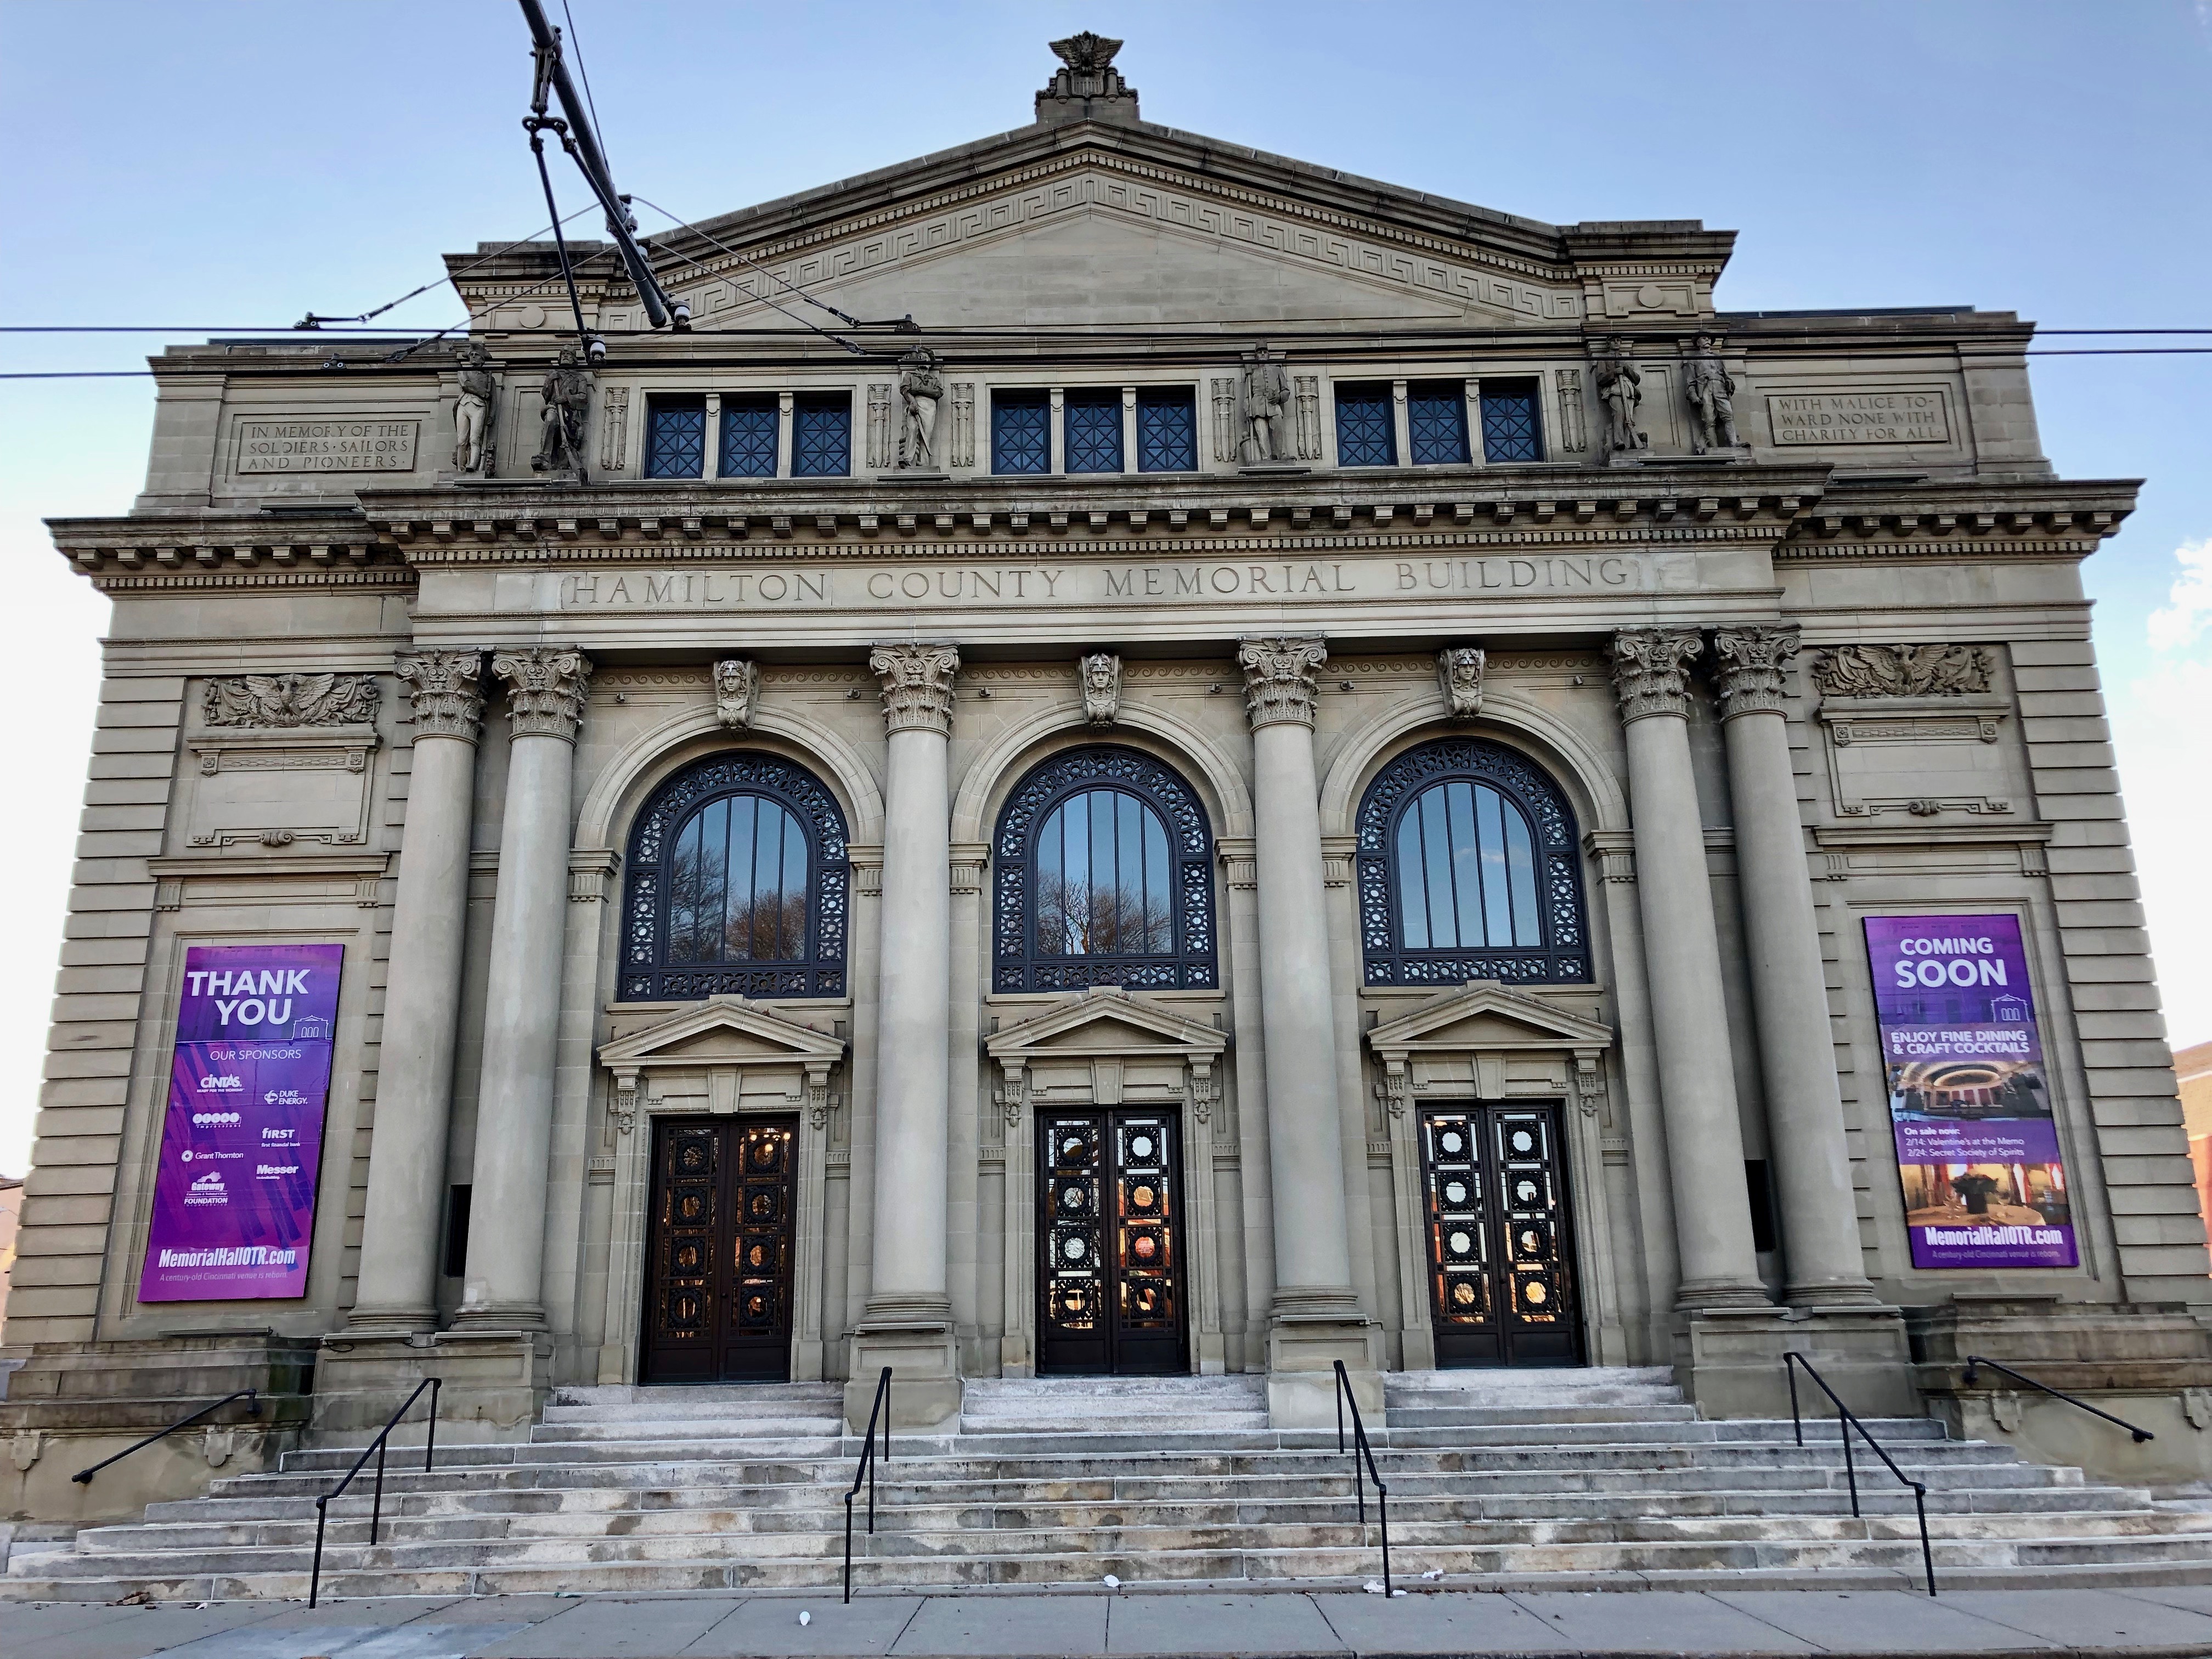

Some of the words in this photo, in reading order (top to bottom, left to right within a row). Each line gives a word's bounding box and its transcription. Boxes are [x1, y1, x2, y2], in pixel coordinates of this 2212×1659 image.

[1779, 399, 1821, 410] WITH
[1831, 397, 1895, 410] MALICE
[1782, 414, 1832, 426] WARD
[1839, 413, 1884, 425] NONE
[1893, 411, 1936, 424] WITH
[252, 426, 269, 438] IN
[351, 425, 372, 437] OF
[377, 425, 408, 437] THE
[1783, 428, 1858, 441] CHARITY
[1867, 428, 1897, 439] FOR
[339, 440, 408, 453] SAILORS
[248, 457, 290, 470] AND
[570, 574, 825, 603] HAMILTON
[867, 570, 1065, 599] COUNTY
[1103, 564, 1356, 597] MEMORIAL
[1395, 559, 1627, 590] BUILDING
[1900, 937, 1994, 955] COMING
[1895, 959, 2008, 988] SOON
[187, 969, 311, 996] THANK
[215, 998, 292, 1025] YOU
[1891, 1031, 1937, 1042] ENJOY
[1940, 1031, 1972, 1042] FINE
[1975, 1030, 2028, 1042] DINING
[210, 1051, 235, 1060] OUR
[239, 1049, 302, 1060] SPONSORS
[1893, 1044, 1904, 1054] &
[1906, 1043, 1950, 1054] CRAFT
[1954, 1042, 2030, 1053] COCKTAILS
[194, 1113, 239, 1122] DECAL
[1919, 1126, 1937, 1135] sale
[1905, 1138, 1927, 1146] 2/14:
[1982, 1137, 1996, 1145] the
[1997, 1137, 2024, 1146] Memo
[1957, 1148, 1987, 1158] Society
[1988, 1147, 1997, 1156] of
[256, 1165, 299, 1175] Messer
[191, 1182, 225, 1191] Gateway
[1925, 1226, 2063, 1245] MemorialHallOTR.com
[158, 1246, 296, 1268] MemorialHallOTR.com
[160, 1273, 165, 1282] A
[204, 1272, 235, 1280] Cincinnati
